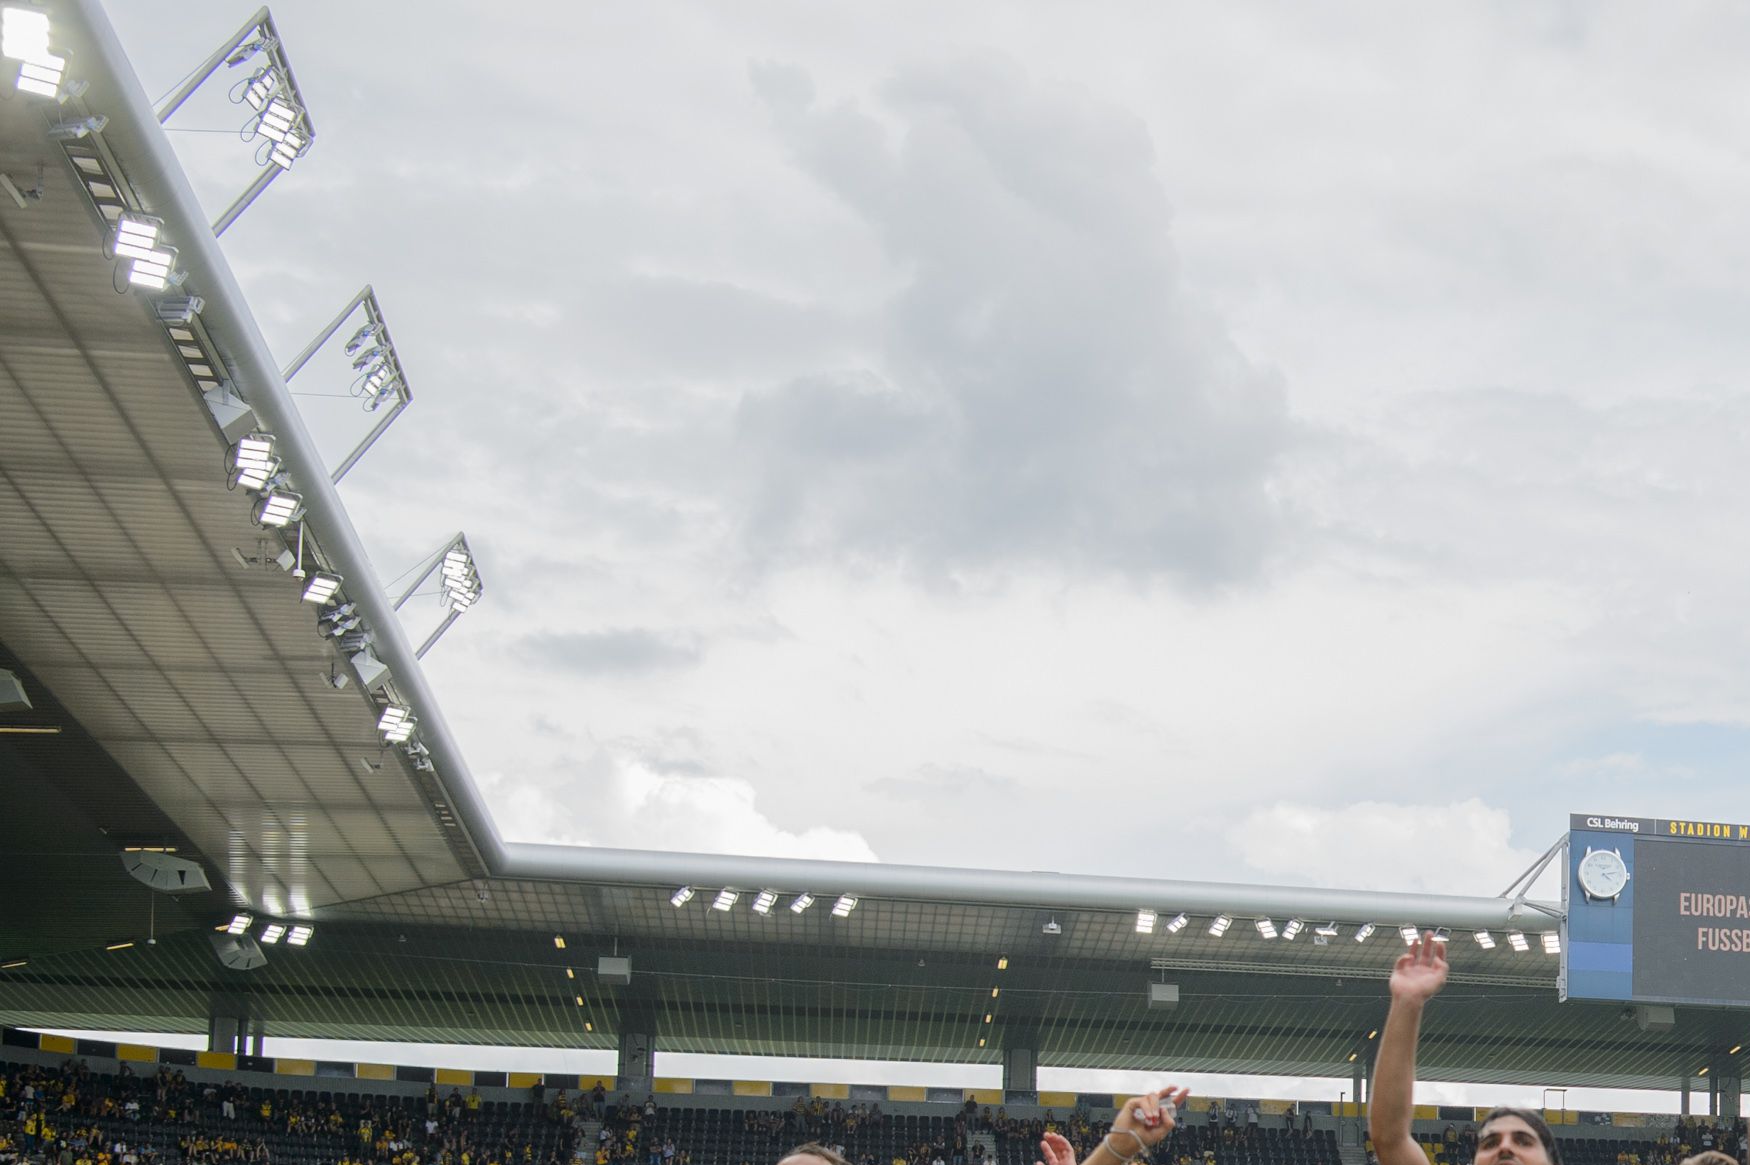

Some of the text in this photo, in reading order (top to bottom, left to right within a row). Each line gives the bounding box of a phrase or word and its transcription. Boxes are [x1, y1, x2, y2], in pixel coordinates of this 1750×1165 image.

[1587, 817, 1639, 833] CSL Behring
[1670, 821, 1731, 838] STADION
